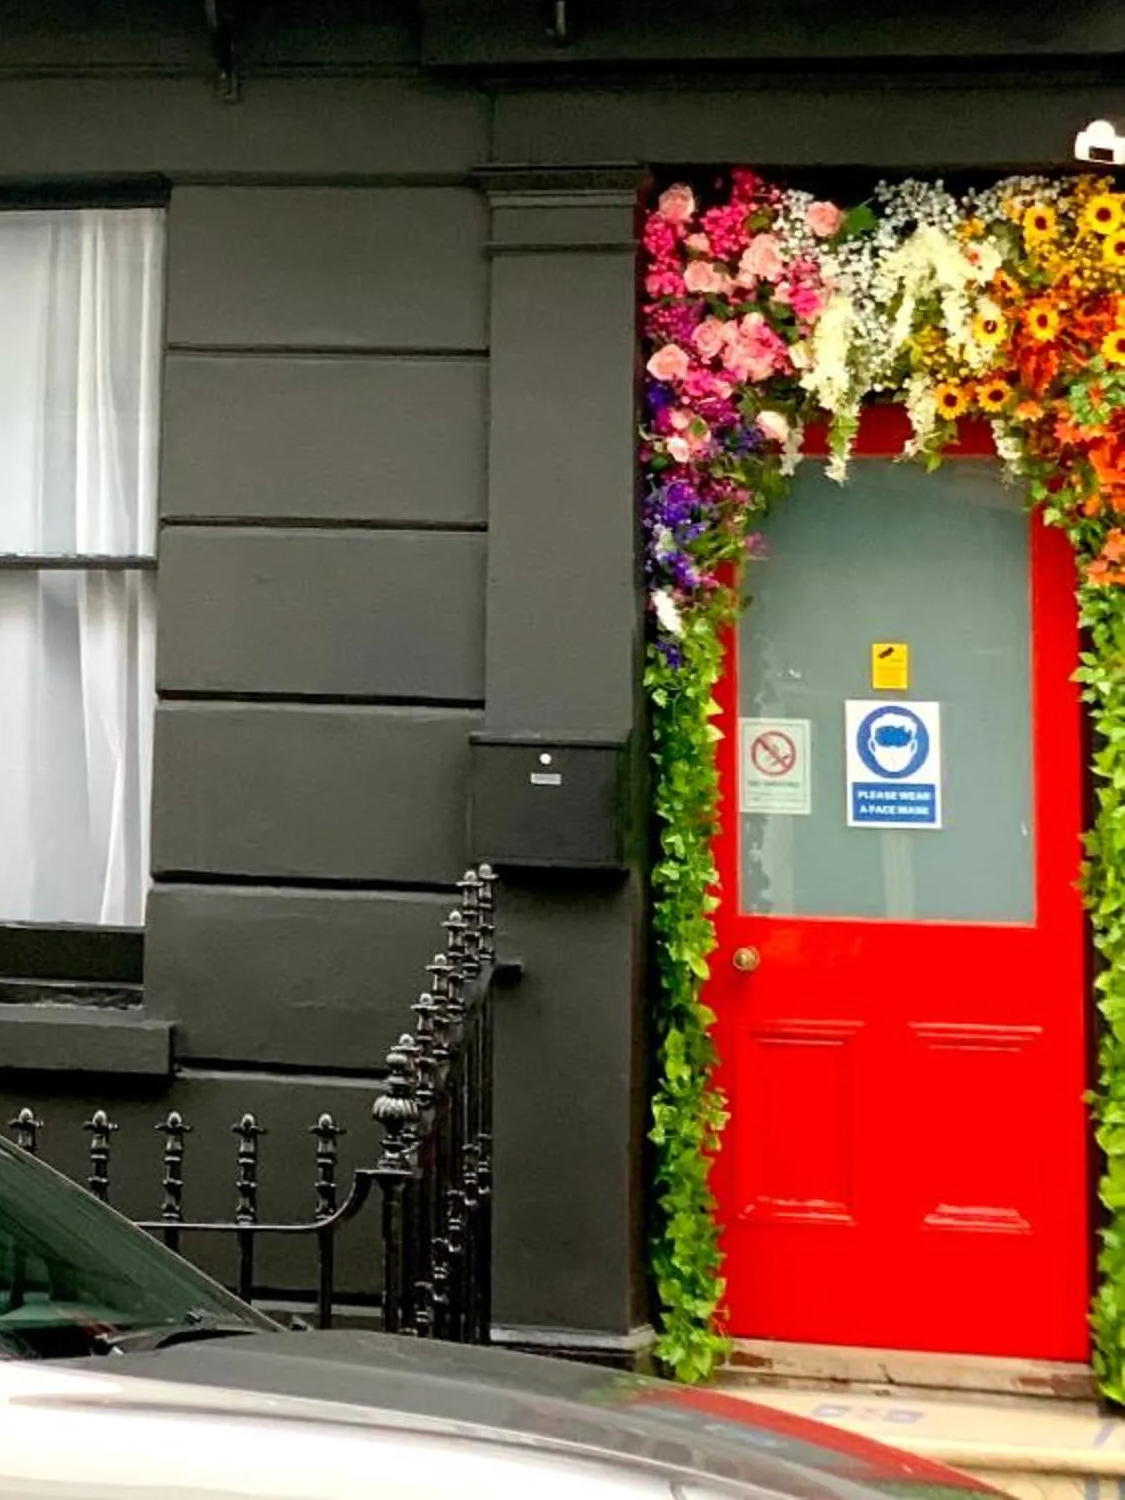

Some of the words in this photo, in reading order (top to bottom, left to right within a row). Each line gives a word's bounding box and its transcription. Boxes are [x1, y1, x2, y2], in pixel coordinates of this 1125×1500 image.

[858, 790, 897, 801] PLEASE
[898, 791, 931, 802] WEAR
[869, 804, 895, 815] FACE
[897, 805, 930, 816] MASK
